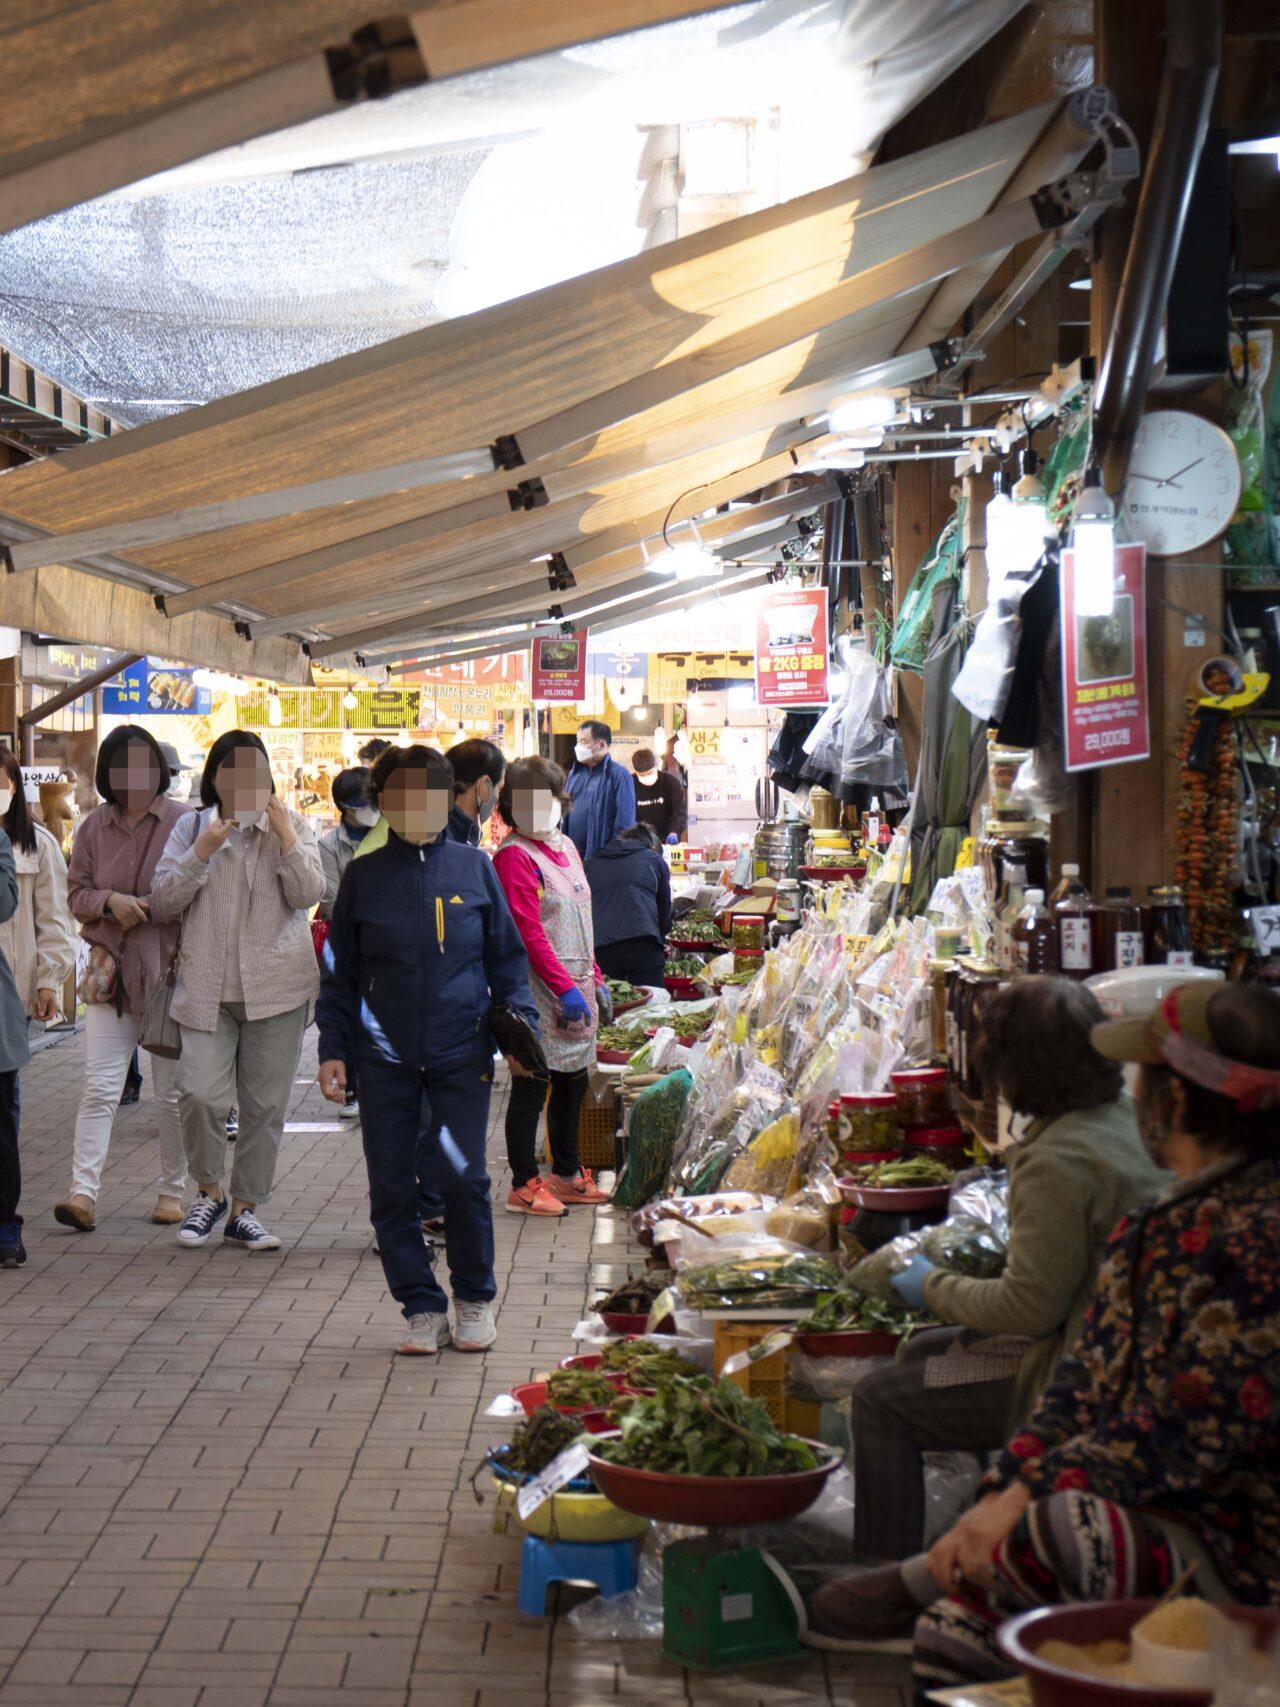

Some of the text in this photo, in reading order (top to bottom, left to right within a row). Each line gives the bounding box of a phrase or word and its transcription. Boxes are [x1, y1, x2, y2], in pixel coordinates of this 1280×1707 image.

[1159, 420, 1181, 440] 12
[1210, 447, 1226, 468] 2
[773, 656, 800, 672] 2KG
[801, 654, 825, 671] 증정
